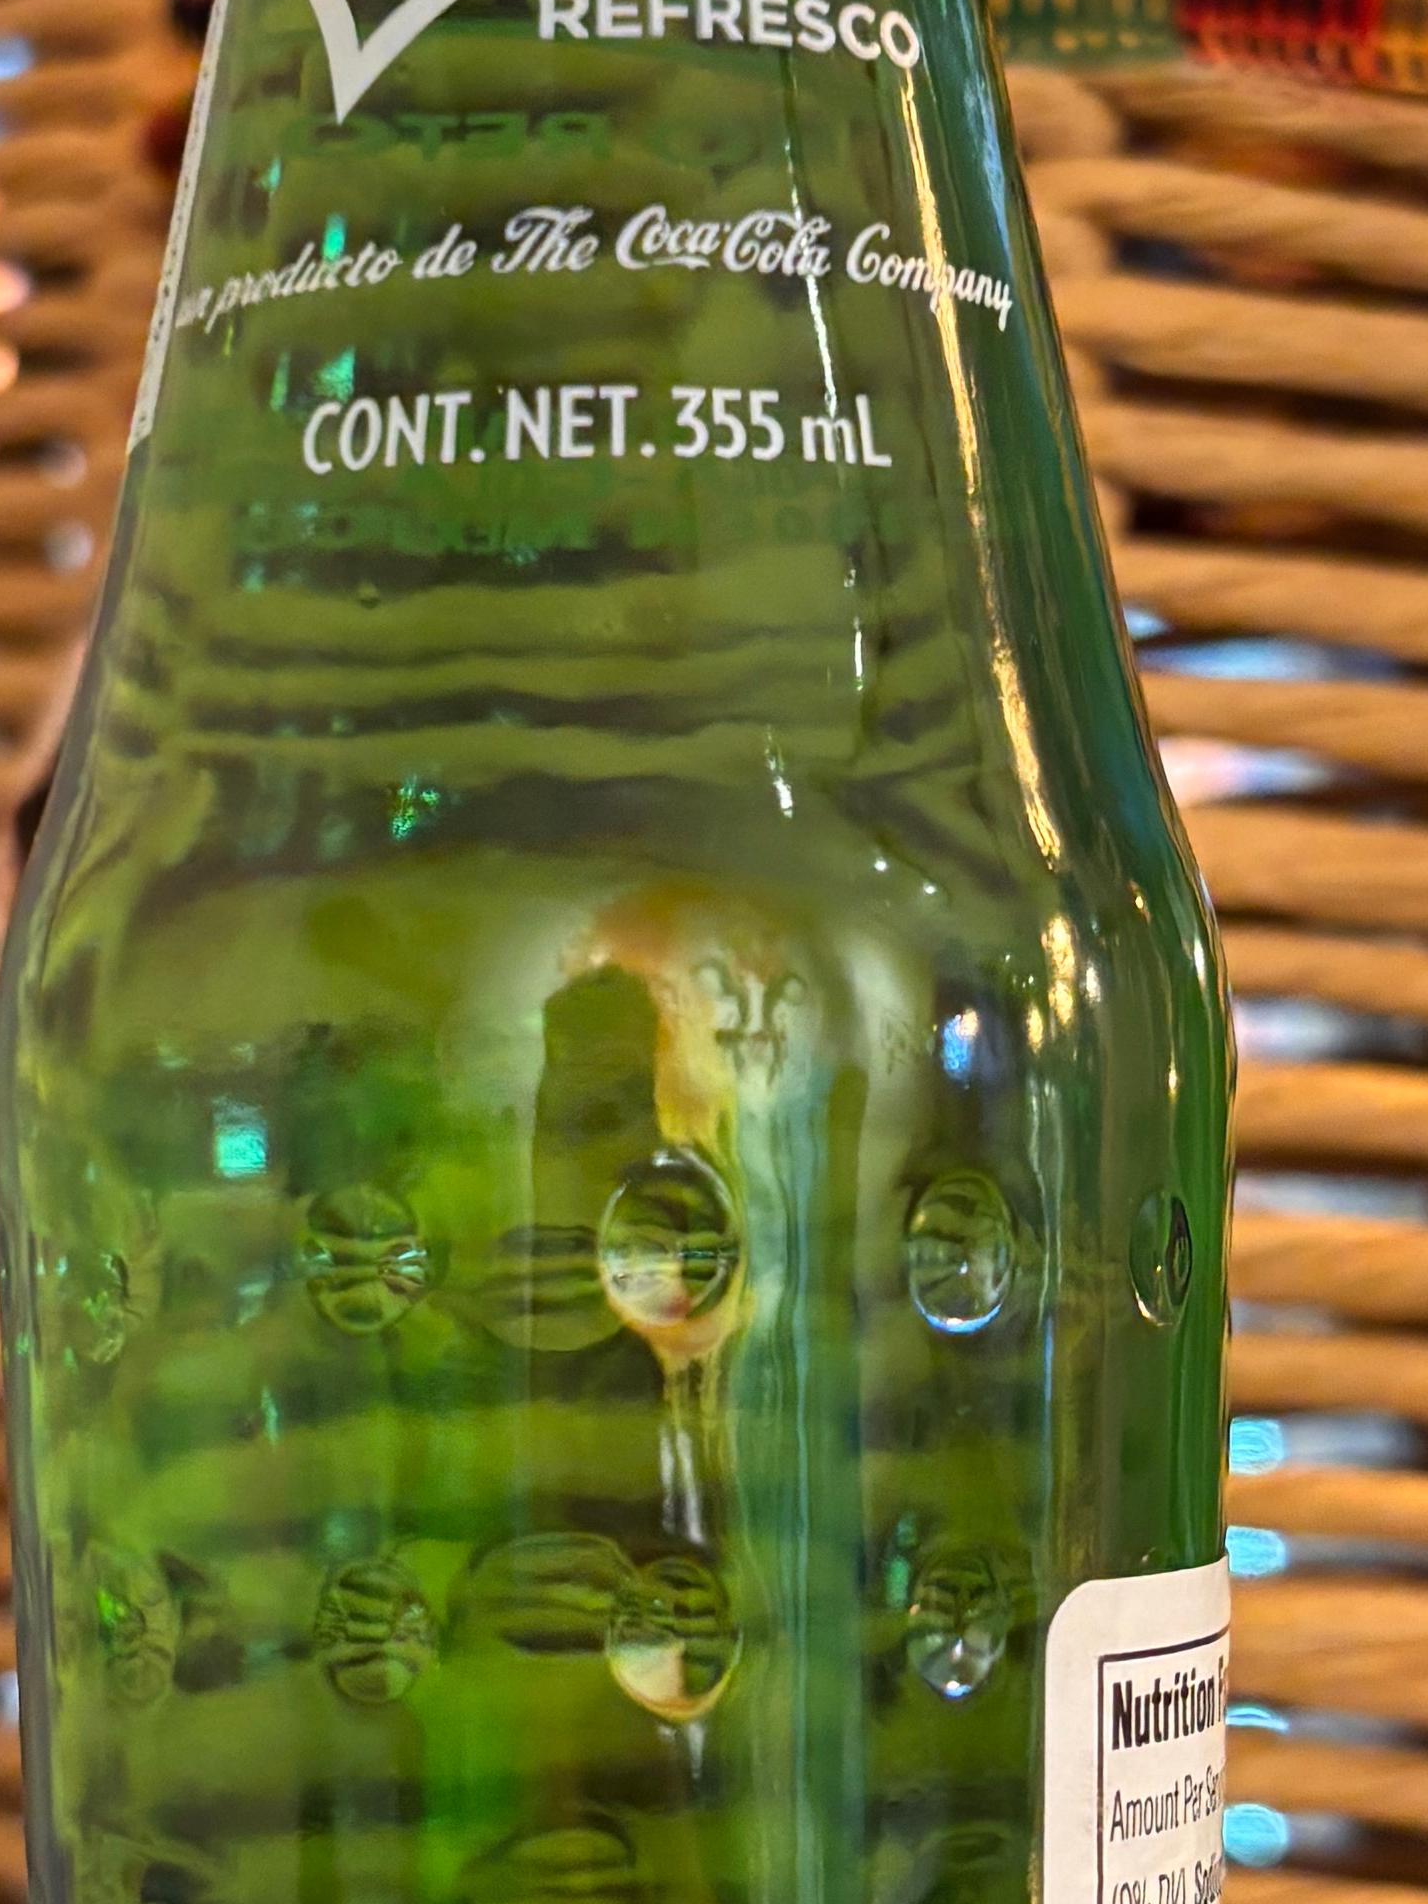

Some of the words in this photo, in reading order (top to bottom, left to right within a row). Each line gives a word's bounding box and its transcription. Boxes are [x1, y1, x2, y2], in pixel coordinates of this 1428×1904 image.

[204, 241, 403, 334] producto
[411, 222, 478, 280] de
[491, 203, 600, 274] The
[846, 221, 1014, 332] Company
[302, 391, 485, 475] CONT.
[504, 385, 657, 461] NET.
[671, 386, 785, 461] 355
[801, 394, 893, 468] mL
[1111, 1666, 1215, 1751] Nutrition
[1109, 1789, 1180, 1843] Amount
[1183, 1773, 1204, 1824] Per
